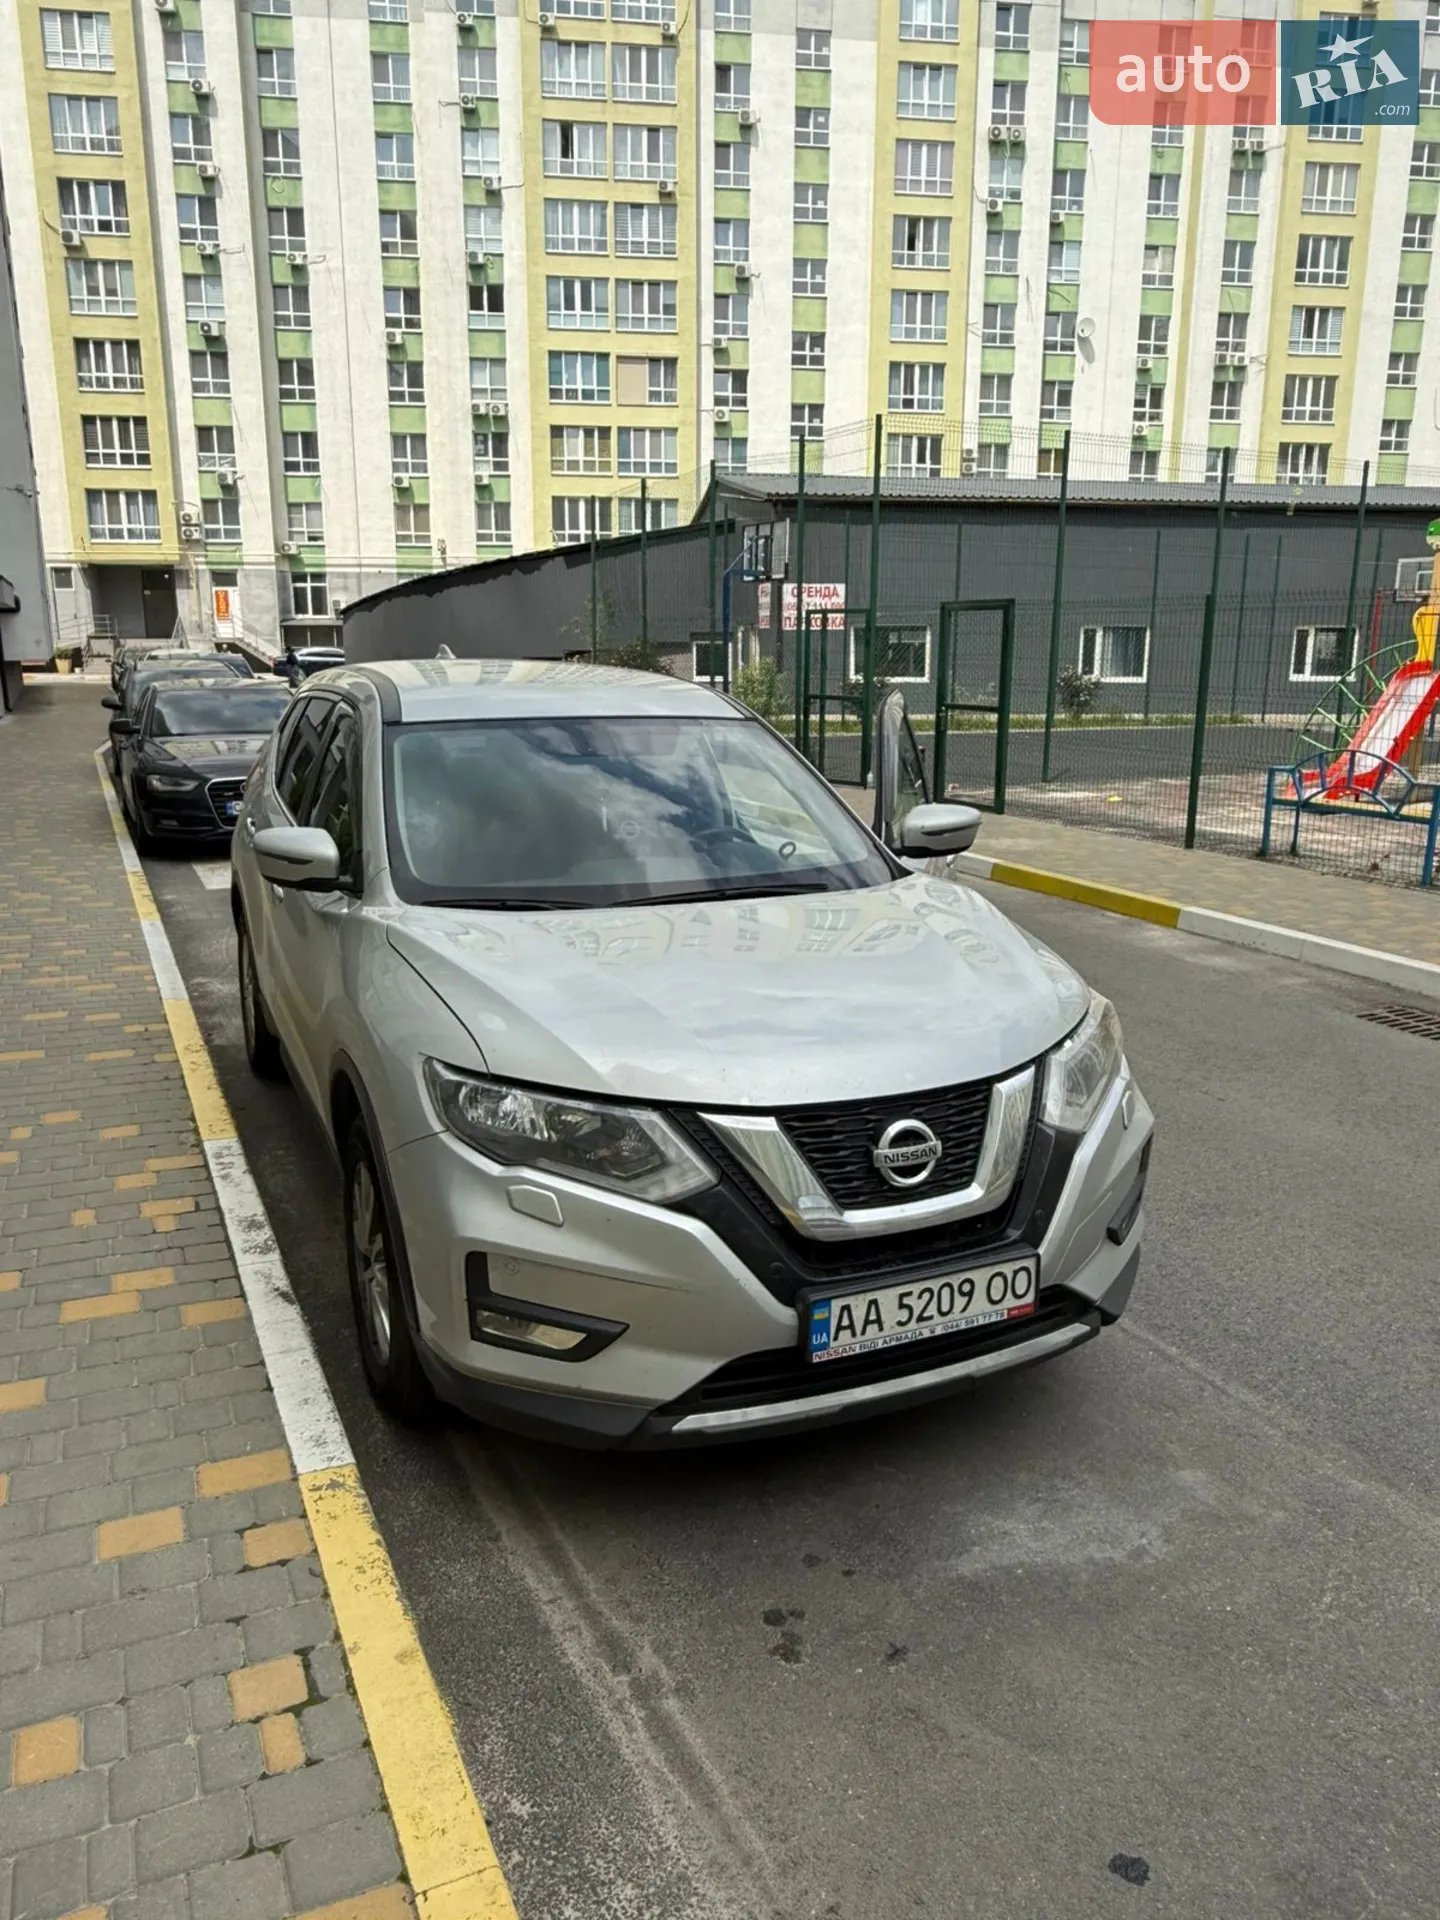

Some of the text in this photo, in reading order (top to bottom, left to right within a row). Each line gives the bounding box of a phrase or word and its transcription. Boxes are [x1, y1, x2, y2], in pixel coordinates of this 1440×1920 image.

[883, 1146, 937, 1164] NISSAN
[832, 1265, 1032, 1341] AA 5209 OO
[812, 1332, 828, 1345] UA
[814, 1345, 857, 1361] NISSAN
